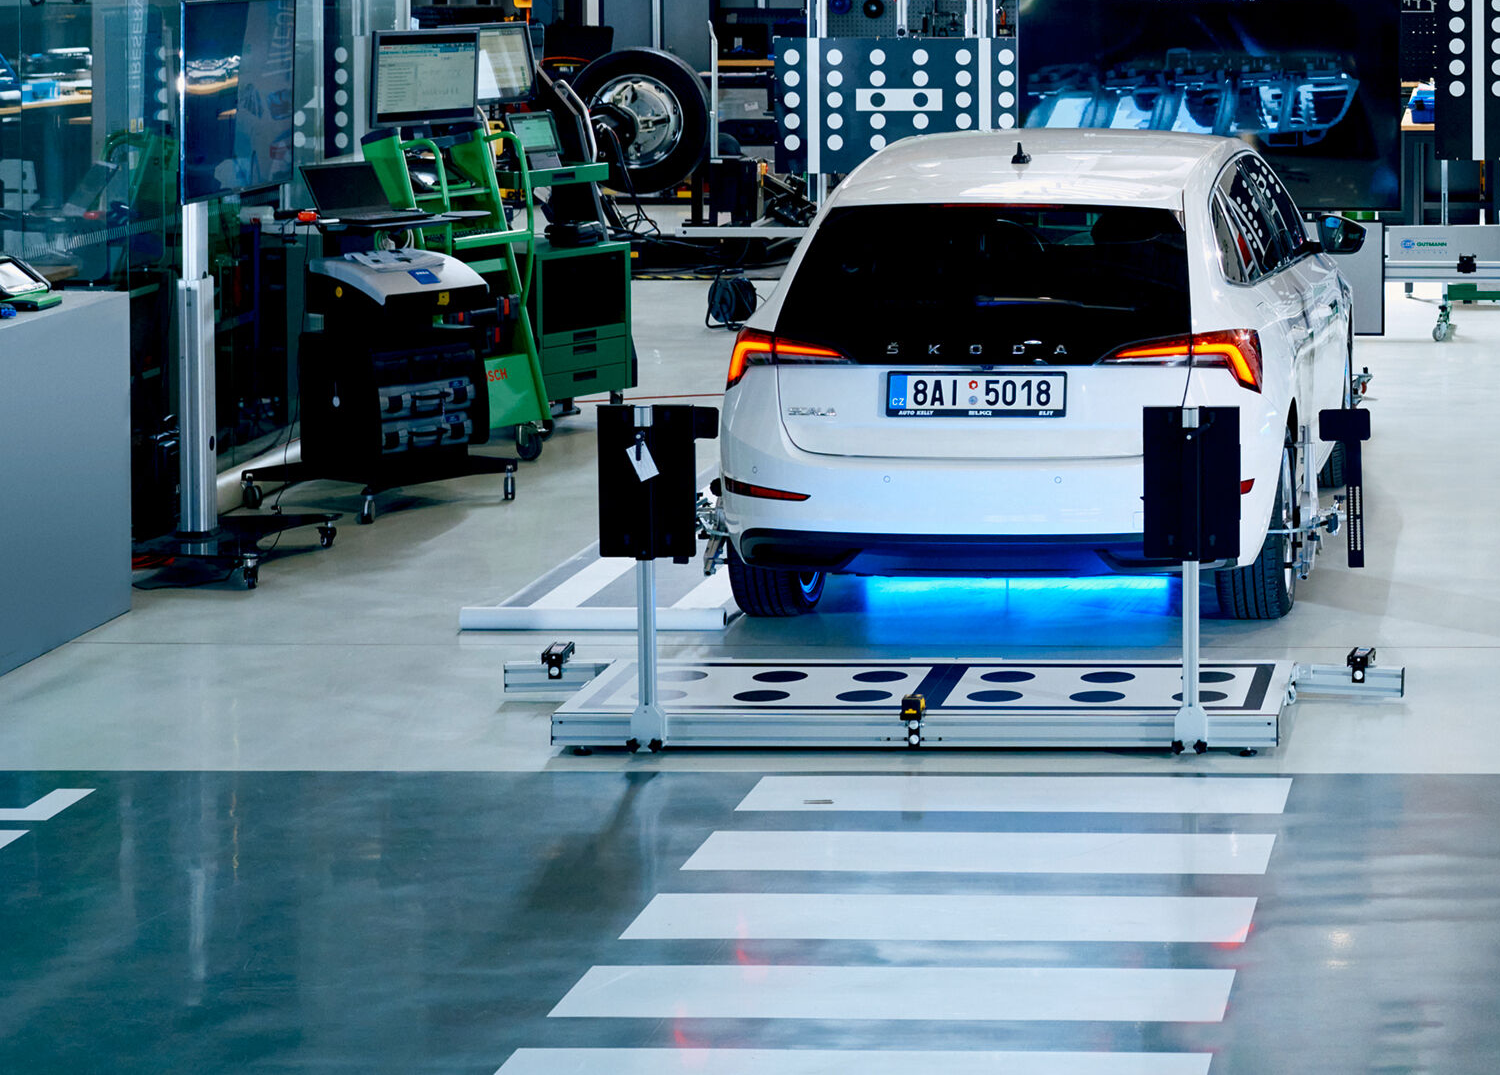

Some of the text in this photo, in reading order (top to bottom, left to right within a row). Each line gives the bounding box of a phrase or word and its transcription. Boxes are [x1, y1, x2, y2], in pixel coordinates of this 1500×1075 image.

[886, 342, 1067, 355] ŠKODA
[486, 368, 508, 382] SCH
[913, 380, 1051, 406] 8AI 5018
[892, 398, 904, 406] CZ
